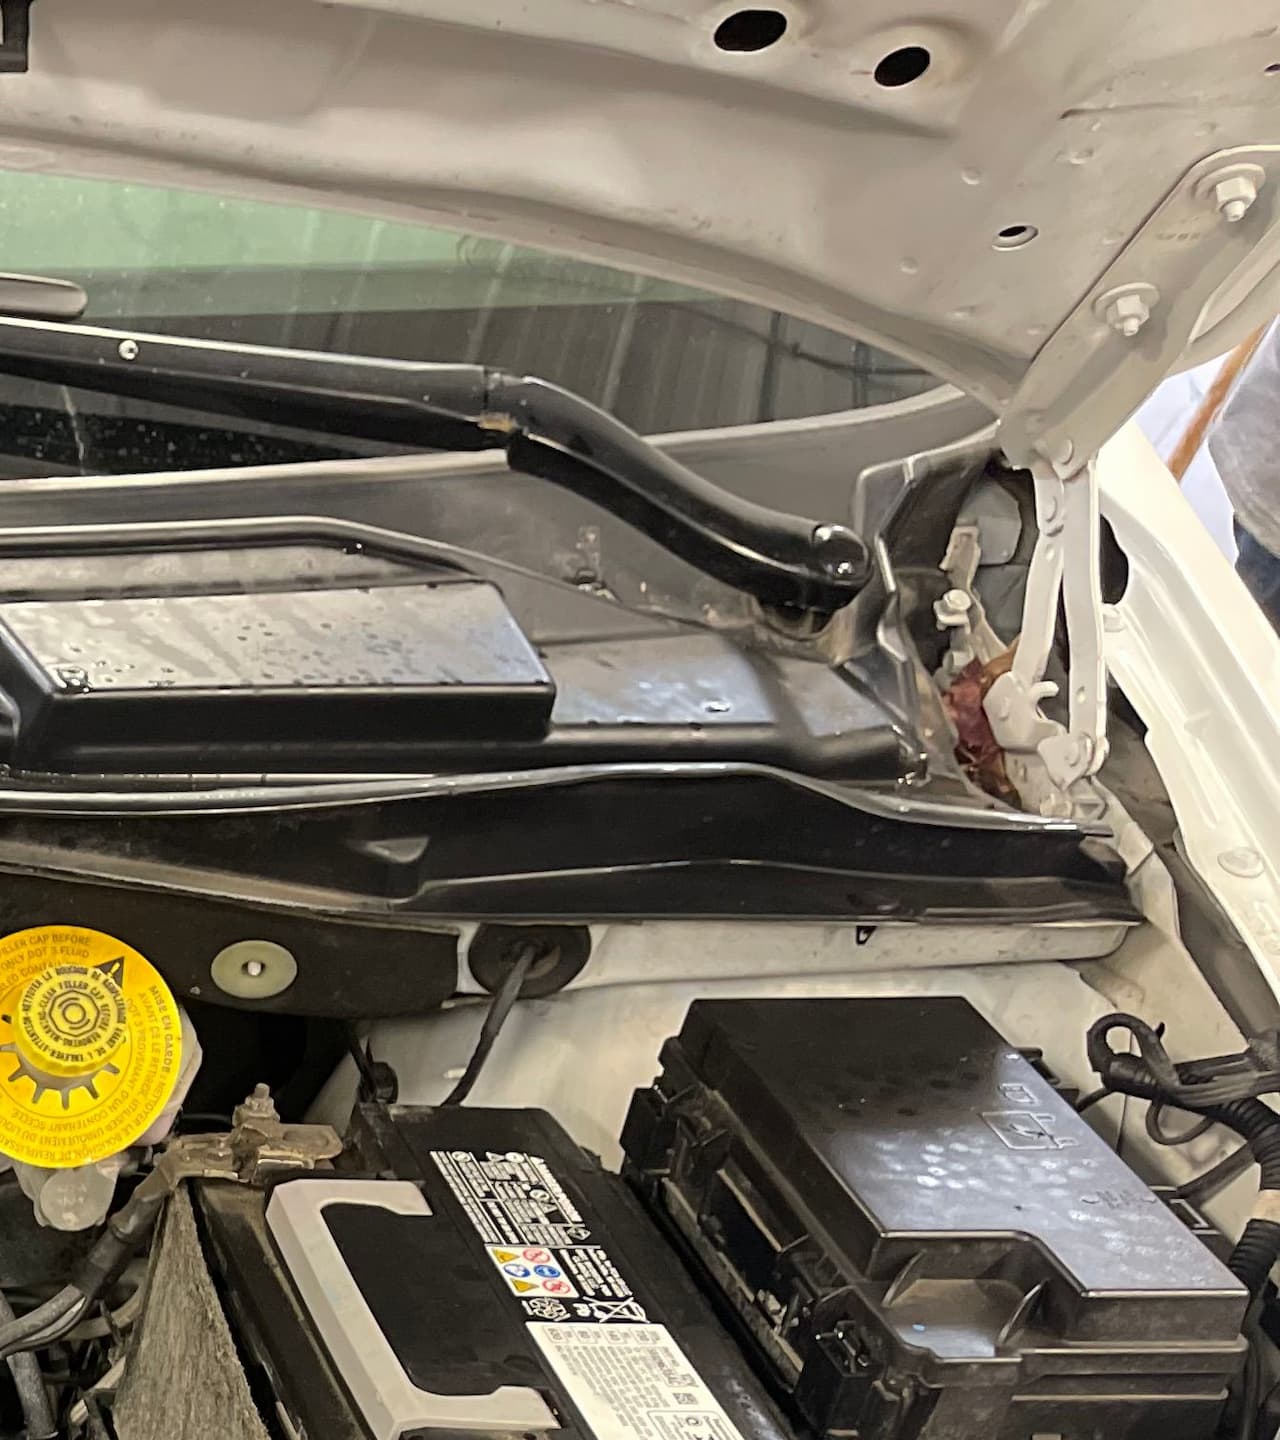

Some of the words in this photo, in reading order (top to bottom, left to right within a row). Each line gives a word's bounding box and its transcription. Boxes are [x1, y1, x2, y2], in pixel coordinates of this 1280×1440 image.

[29, 934, 49, 946] CAP
[52, 933, 90, 945] BEFORE
[1, 954, 24, 970] ONLY
[27, 946, 47, 959] DOT
[60, 946, 90, 958] FLUID
[149, 985, 167, 1012] MISE
[162, 1016, 171, 1029] EN
